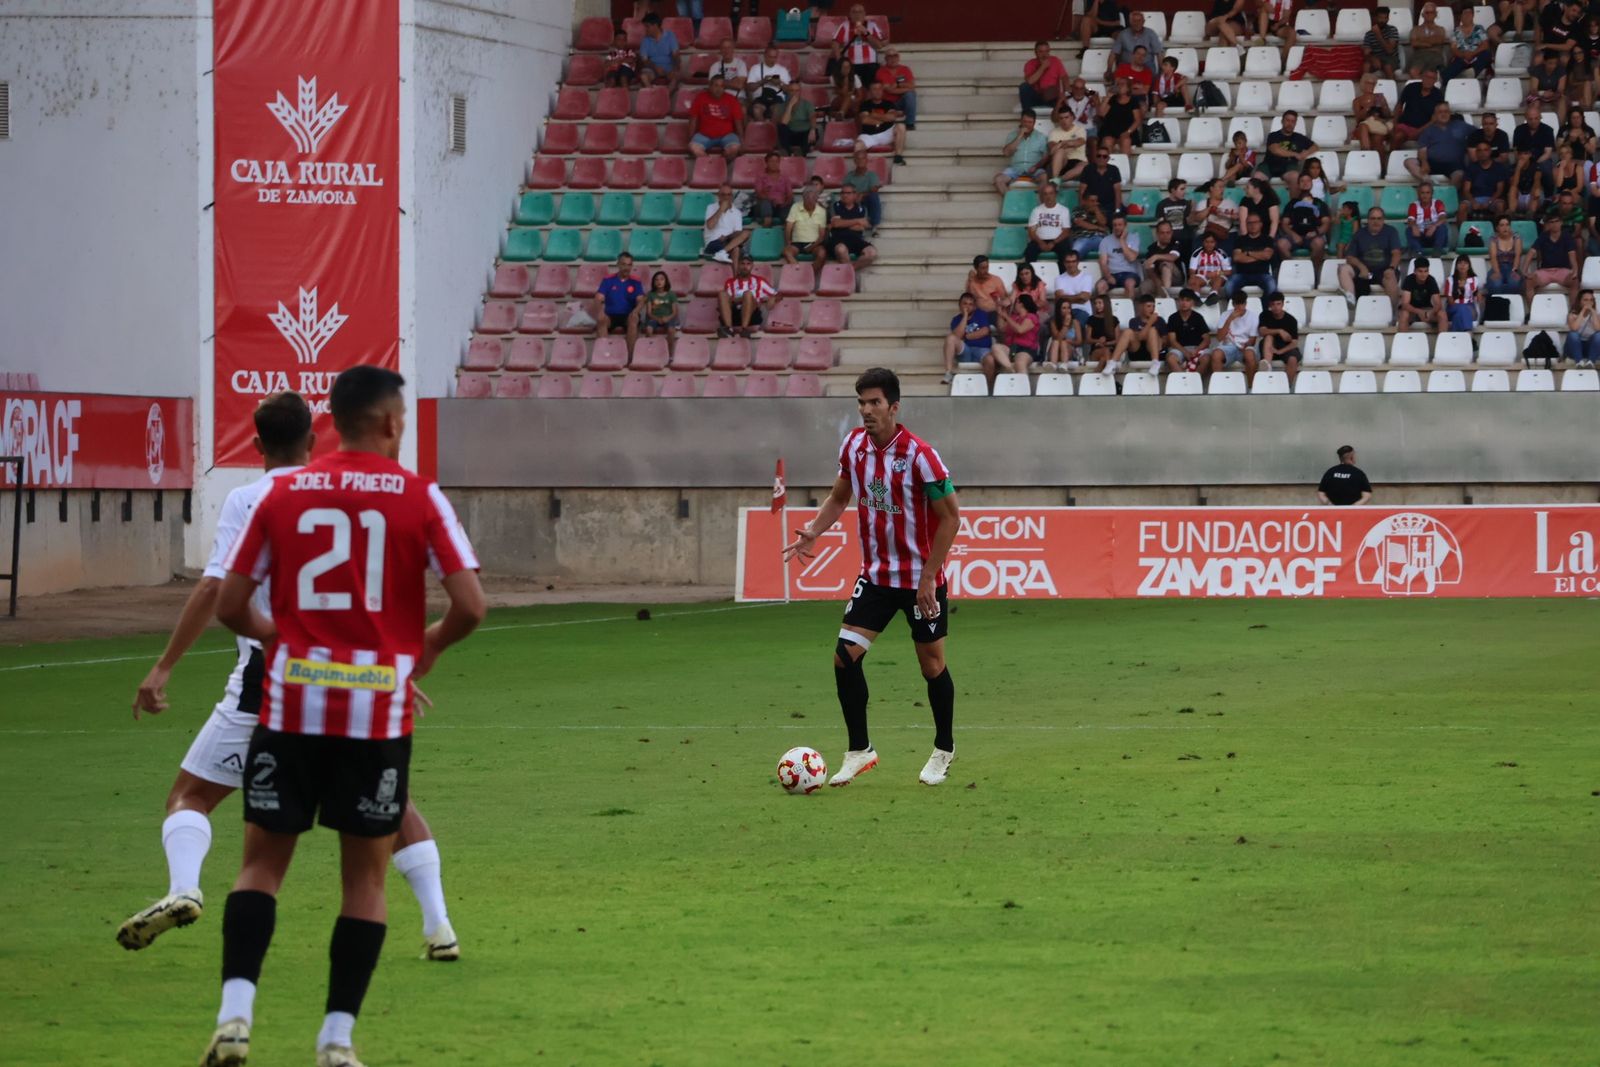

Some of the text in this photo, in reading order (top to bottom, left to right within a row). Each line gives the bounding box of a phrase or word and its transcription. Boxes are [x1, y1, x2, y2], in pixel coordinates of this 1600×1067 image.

[230, 159, 383, 186] CAJA RURAL
[258, 189, 357, 204] DE ZAMORA
[231, 370, 290, 395] CAJA
[0, 398, 82, 485] MORACF
[289, 471, 405, 495] JOEL PRIEGO
[957, 515, 1046, 540] ACION
[1139, 513, 1342, 553] FUNDACIÓN
[1533, 511, 1599, 575] La
[297, 507, 387, 613] 21
[1137, 557, 1342, 597] ZAMORACF
[1554, 576, 1600, 593] El C
[289, 658, 391, 685] Rapimueble
